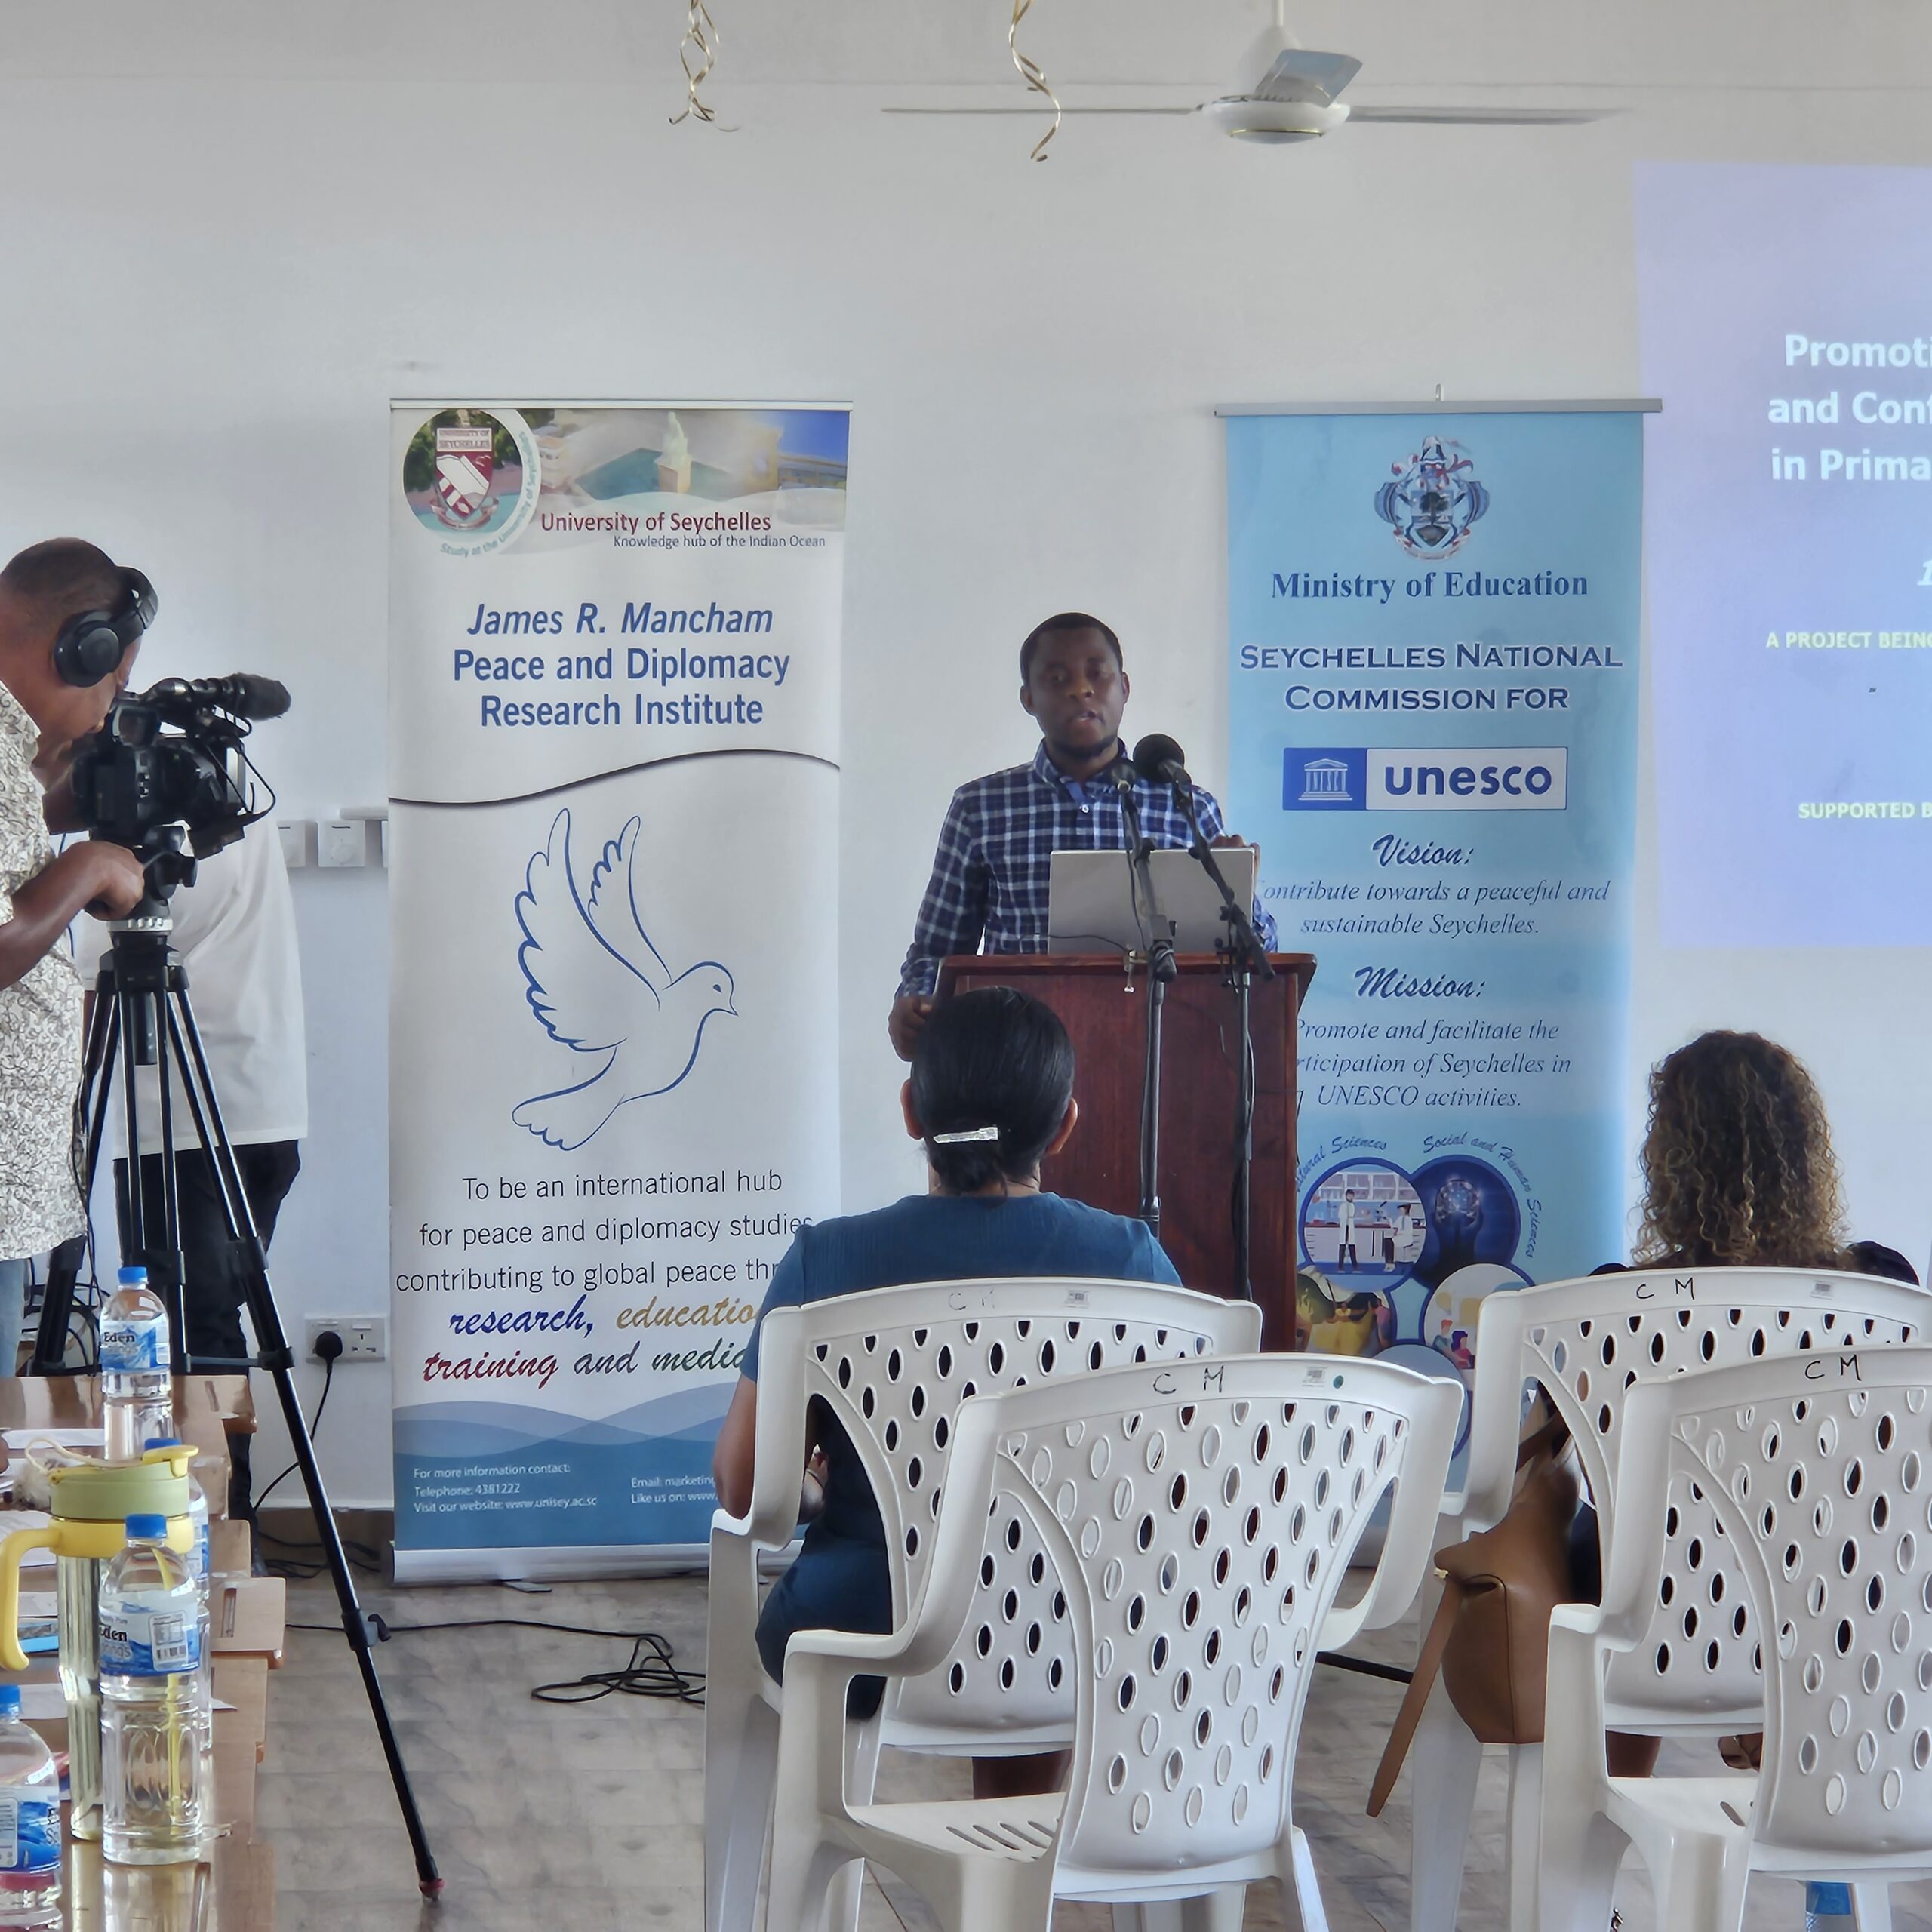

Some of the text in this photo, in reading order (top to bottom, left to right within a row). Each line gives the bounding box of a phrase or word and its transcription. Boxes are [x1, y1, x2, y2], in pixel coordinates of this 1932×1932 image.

[1767, 391, 1838, 423] and
[1772, 448, 1806, 480] in
[541, 512, 638, 535] University
[646, 512, 665, 531] of
[671, 512, 771, 534] Seychelles
[614, 534, 826, 549] Knowledge hub of the Indian Ocean
[1272, 571, 1588, 603] Ministry of Education
[466, 602, 774, 634] James R. Mancham
[1766, 632, 1779, 648] A
[1786, 632, 1872, 648] PROJECT
[454, 648, 790, 686] Peace and Diplomacy
[1241, 643, 1623, 669] SEYCHELLES NATIONAL
[481, 693, 764, 726] Research Institute
[1285, 685, 1569, 710] COMMISSION FOR
[1384, 764, 1552, 796] unesco
[1798, 803, 1915, 819] SUPPORTED
[1371, 834, 1473, 866] Vision:
[1263, 880, 1610, 906] ontribute towards a peaceful and
[1300, 914, 1540, 938] sustainable Seychelles.
[1354, 965, 1485, 998] Mission:
[1386, 1019, 1424, 1038] and
[1428, 1019, 1521, 1044] facilitate
[1528, 1020, 1558, 1039] the
[1297, 1054, 1571, 1078] rticipation of Seychelles in
[1318, 1085, 1521, 1106] UNESCO activities.
[1332, 1135, 1387, 1153] Sciences
[463, 1170, 782, 1200] To be an international hub
[1423, 1131, 1542, 1257] Social and Human Sciences
[420, 1224, 452, 1246] for
[463, 1224, 532, 1251] peace
[542, 1219, 585, 1243] and
[596, 1216, 720, 1245] diplomacy
[396, 1266, 542, 1293] contributing
[552, 1265, 574, 1287] to
[583, 1261, 654, 1291] global
[667, 1263, 736, 1287] peace
[1636, 1277, 1694, 1300] C M
[449, 1294, 758, 1337] research, educatio
[104, 1331, 135, 1342] Eden
[423, 1351, 559, 1389] training
[574, 1341, 640, 1375] and
[1805, 1354, 1862, 1381] C M
[1153, 1365, 1224, 1395] C M
[414, 1464, 570, 1478] For more information contact:
[416, 1484, 520, 1497] Telephone: 4381222
[632, 1494, 651, 1503] Like
[669, 1494, 685, 1502] on:
[414, 1503, 436, 1512] Visit
[440, 1502, 457, 1512] our
[460, 1500, 503, 1511] website:
